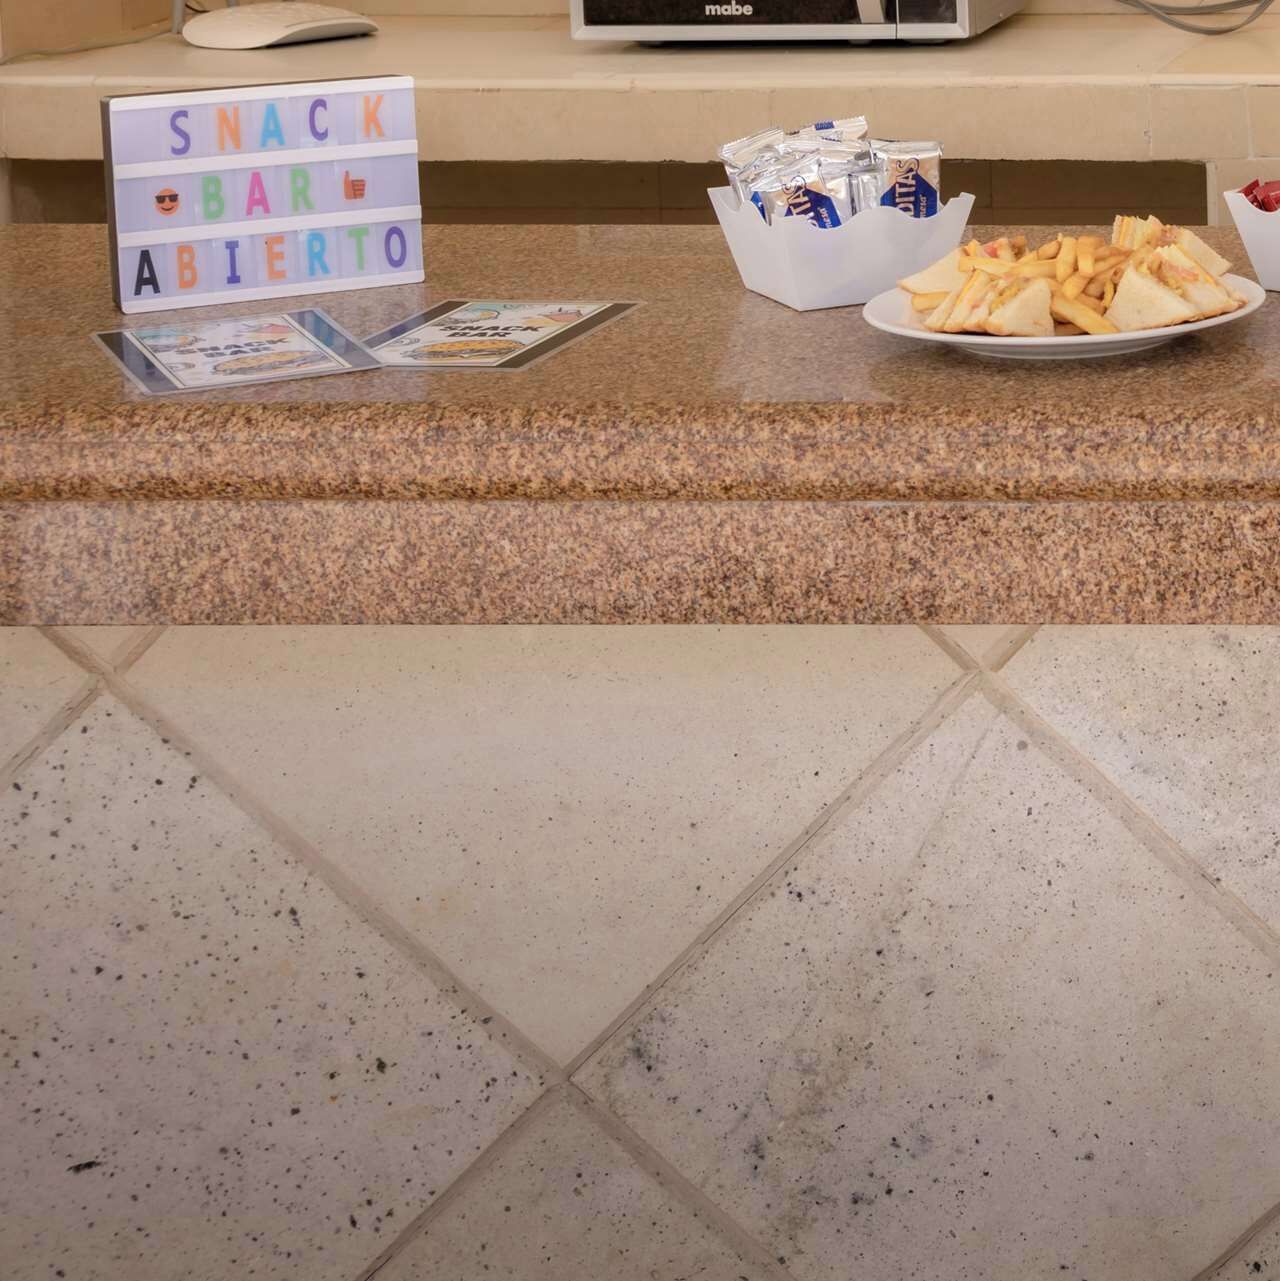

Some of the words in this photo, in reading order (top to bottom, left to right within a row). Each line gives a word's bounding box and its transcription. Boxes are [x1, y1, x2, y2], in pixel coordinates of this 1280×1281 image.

[705, 0, 753, 16] mabe
[169, 94, 385, 156] SNACK
[202, 168, 316, 220] BAR
[133, 226, 408, 296] ABIERTO
[440, 324, 543, 332] SNACK
